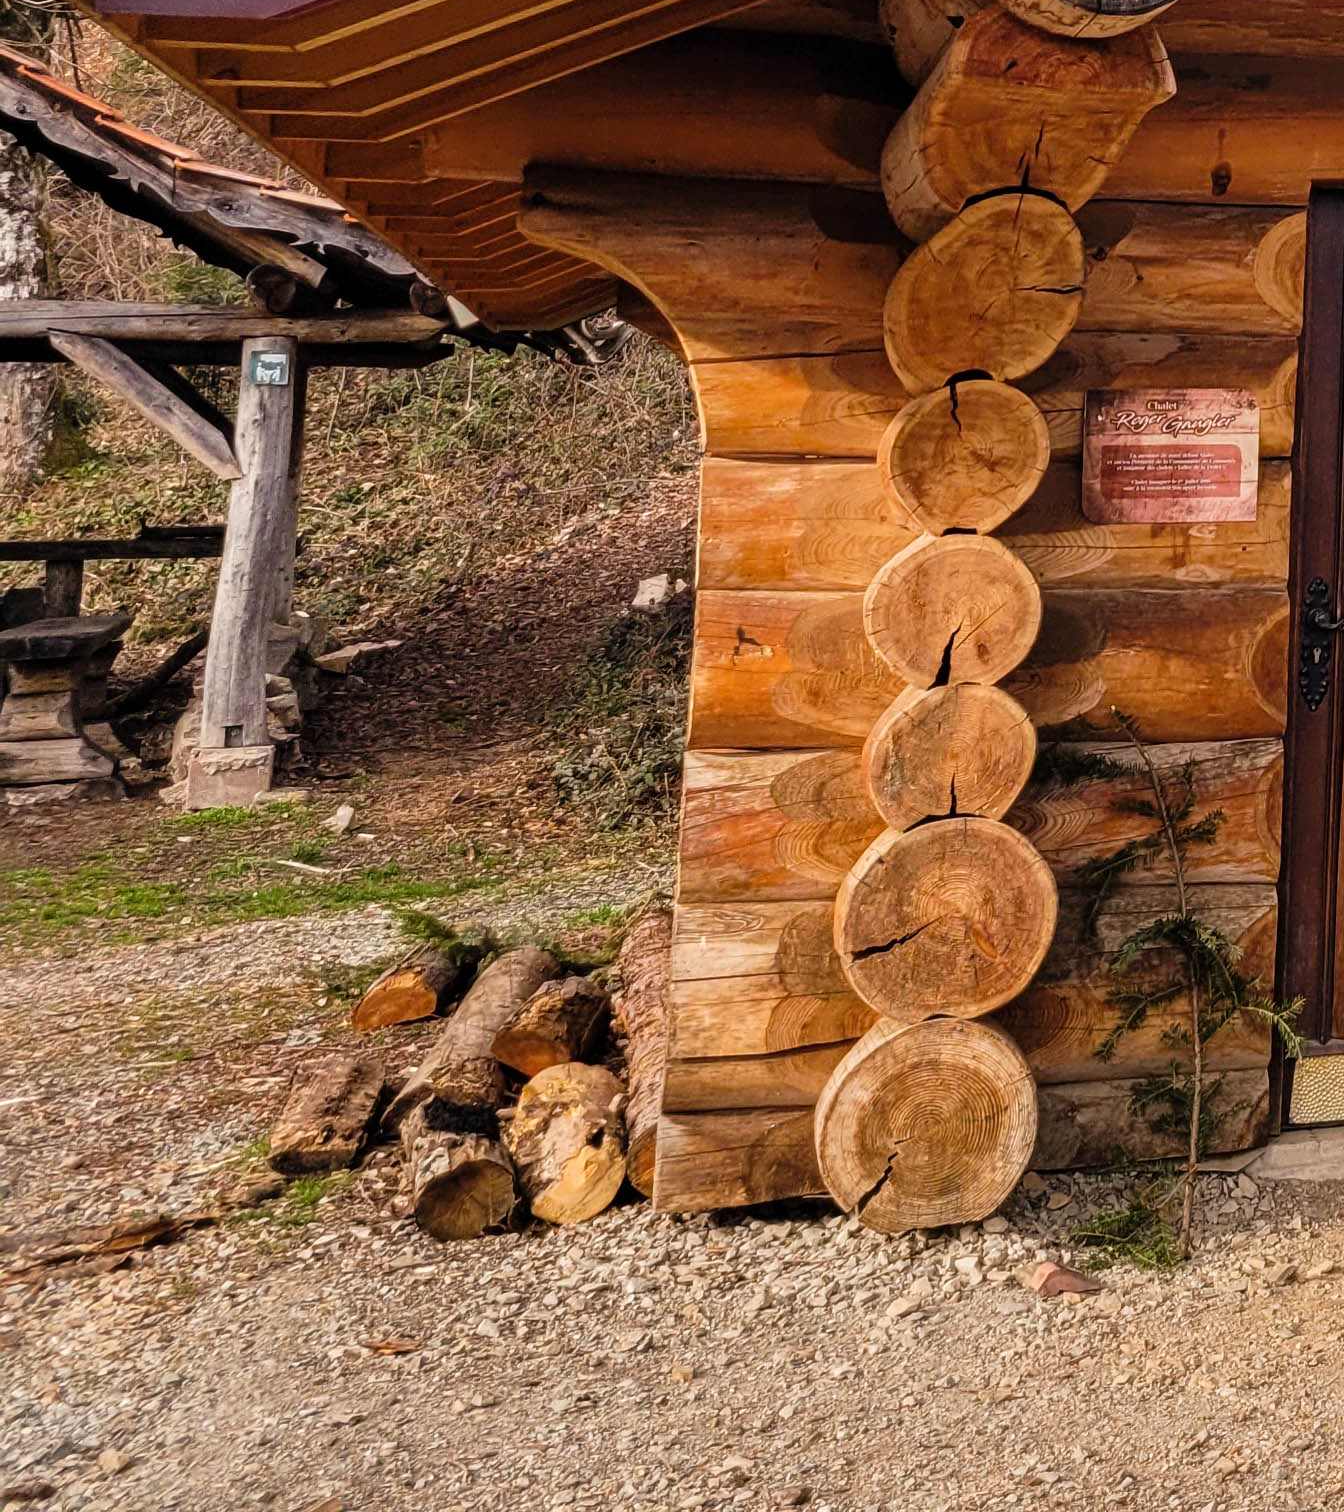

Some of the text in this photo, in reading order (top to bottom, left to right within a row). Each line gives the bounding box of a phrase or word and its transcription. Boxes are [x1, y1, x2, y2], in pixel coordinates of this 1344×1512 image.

[1147, 400, 1177, 410] Chalet
[1112, 410, 1235, 437] Roger Gaugler
